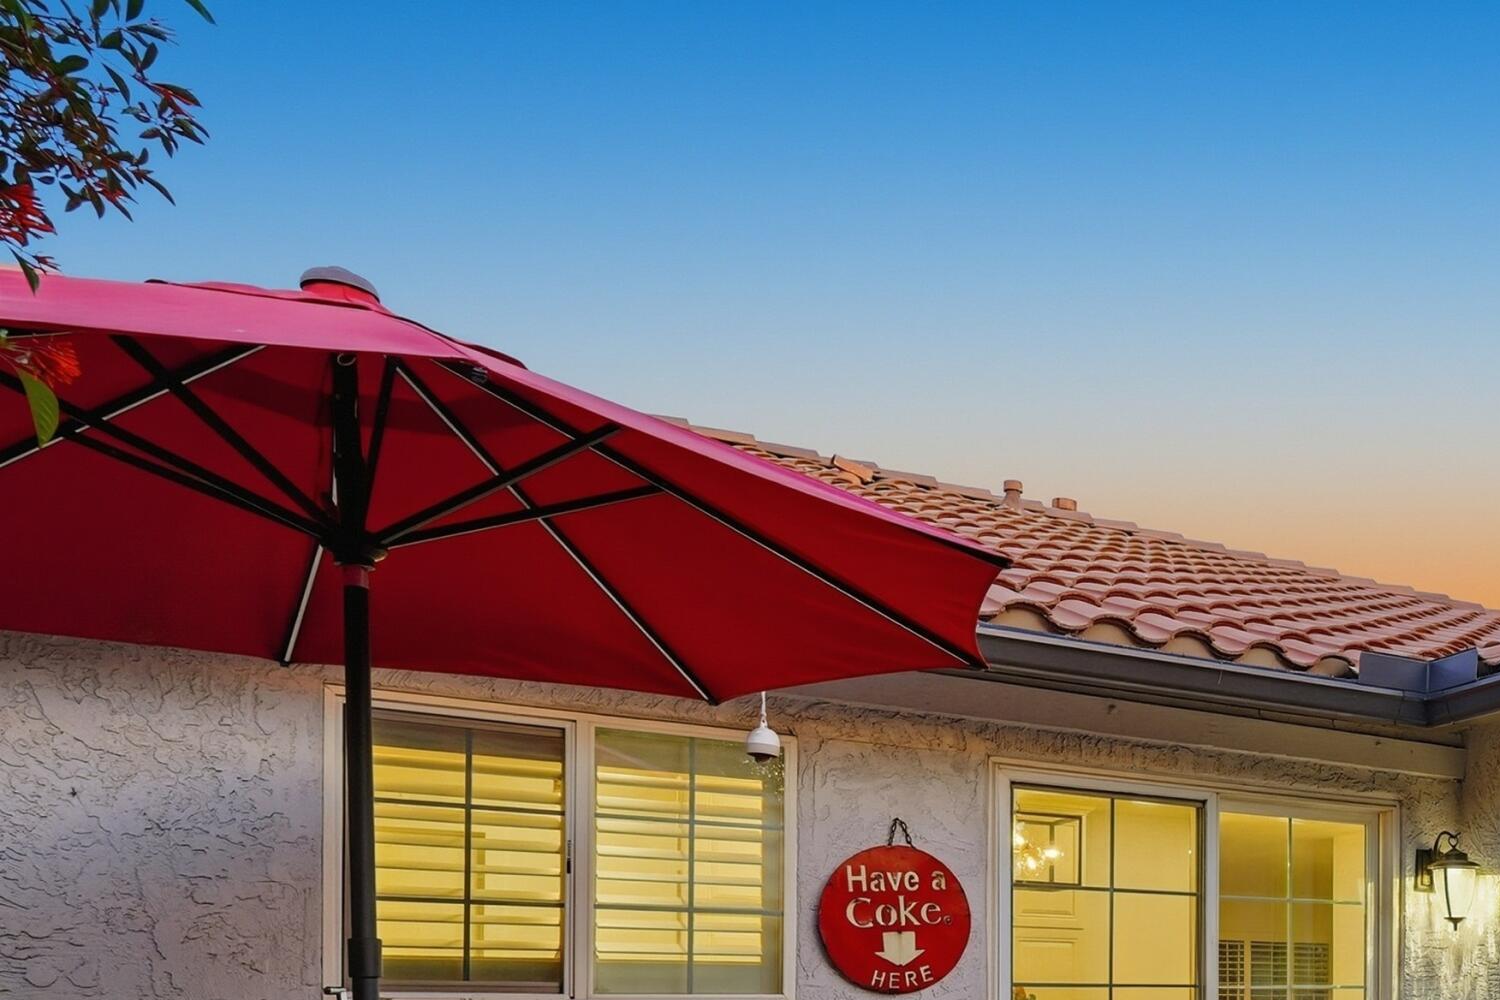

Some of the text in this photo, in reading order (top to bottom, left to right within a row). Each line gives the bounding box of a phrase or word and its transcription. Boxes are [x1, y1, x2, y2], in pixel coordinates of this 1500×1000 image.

[846, 864, 946, 892] Have a
[871, 965, 934, 989] HERE
